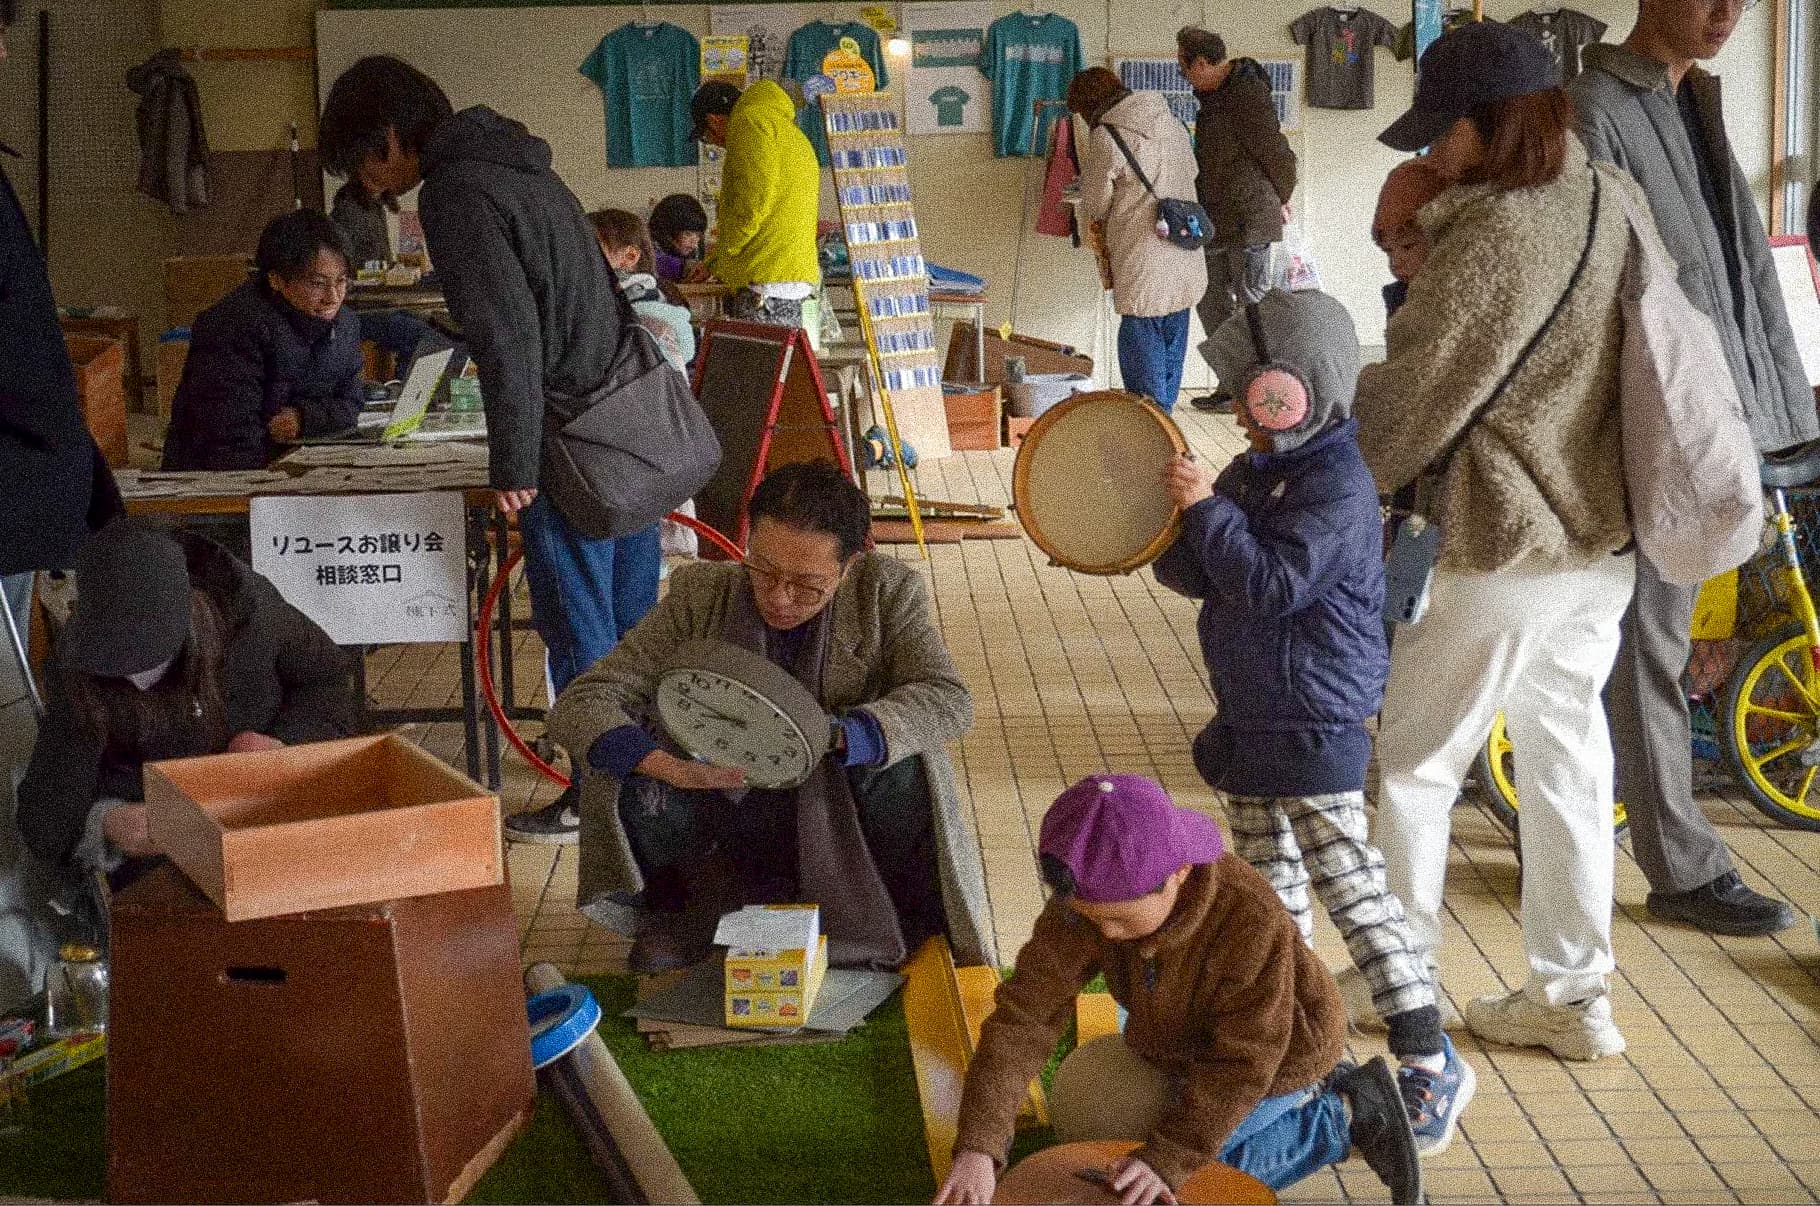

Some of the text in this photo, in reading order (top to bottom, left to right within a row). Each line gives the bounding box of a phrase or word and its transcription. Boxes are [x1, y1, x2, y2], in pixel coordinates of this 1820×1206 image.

[272, 532, 445, 556] リユースお譲り会
[315, 563, 402, 586] 相談窓口
[690, 673, 710, 690] 10
[693, 721, 705, 730] 7
[743, 751, 757, 763] 5
[767, 754, 781, 765] 4
